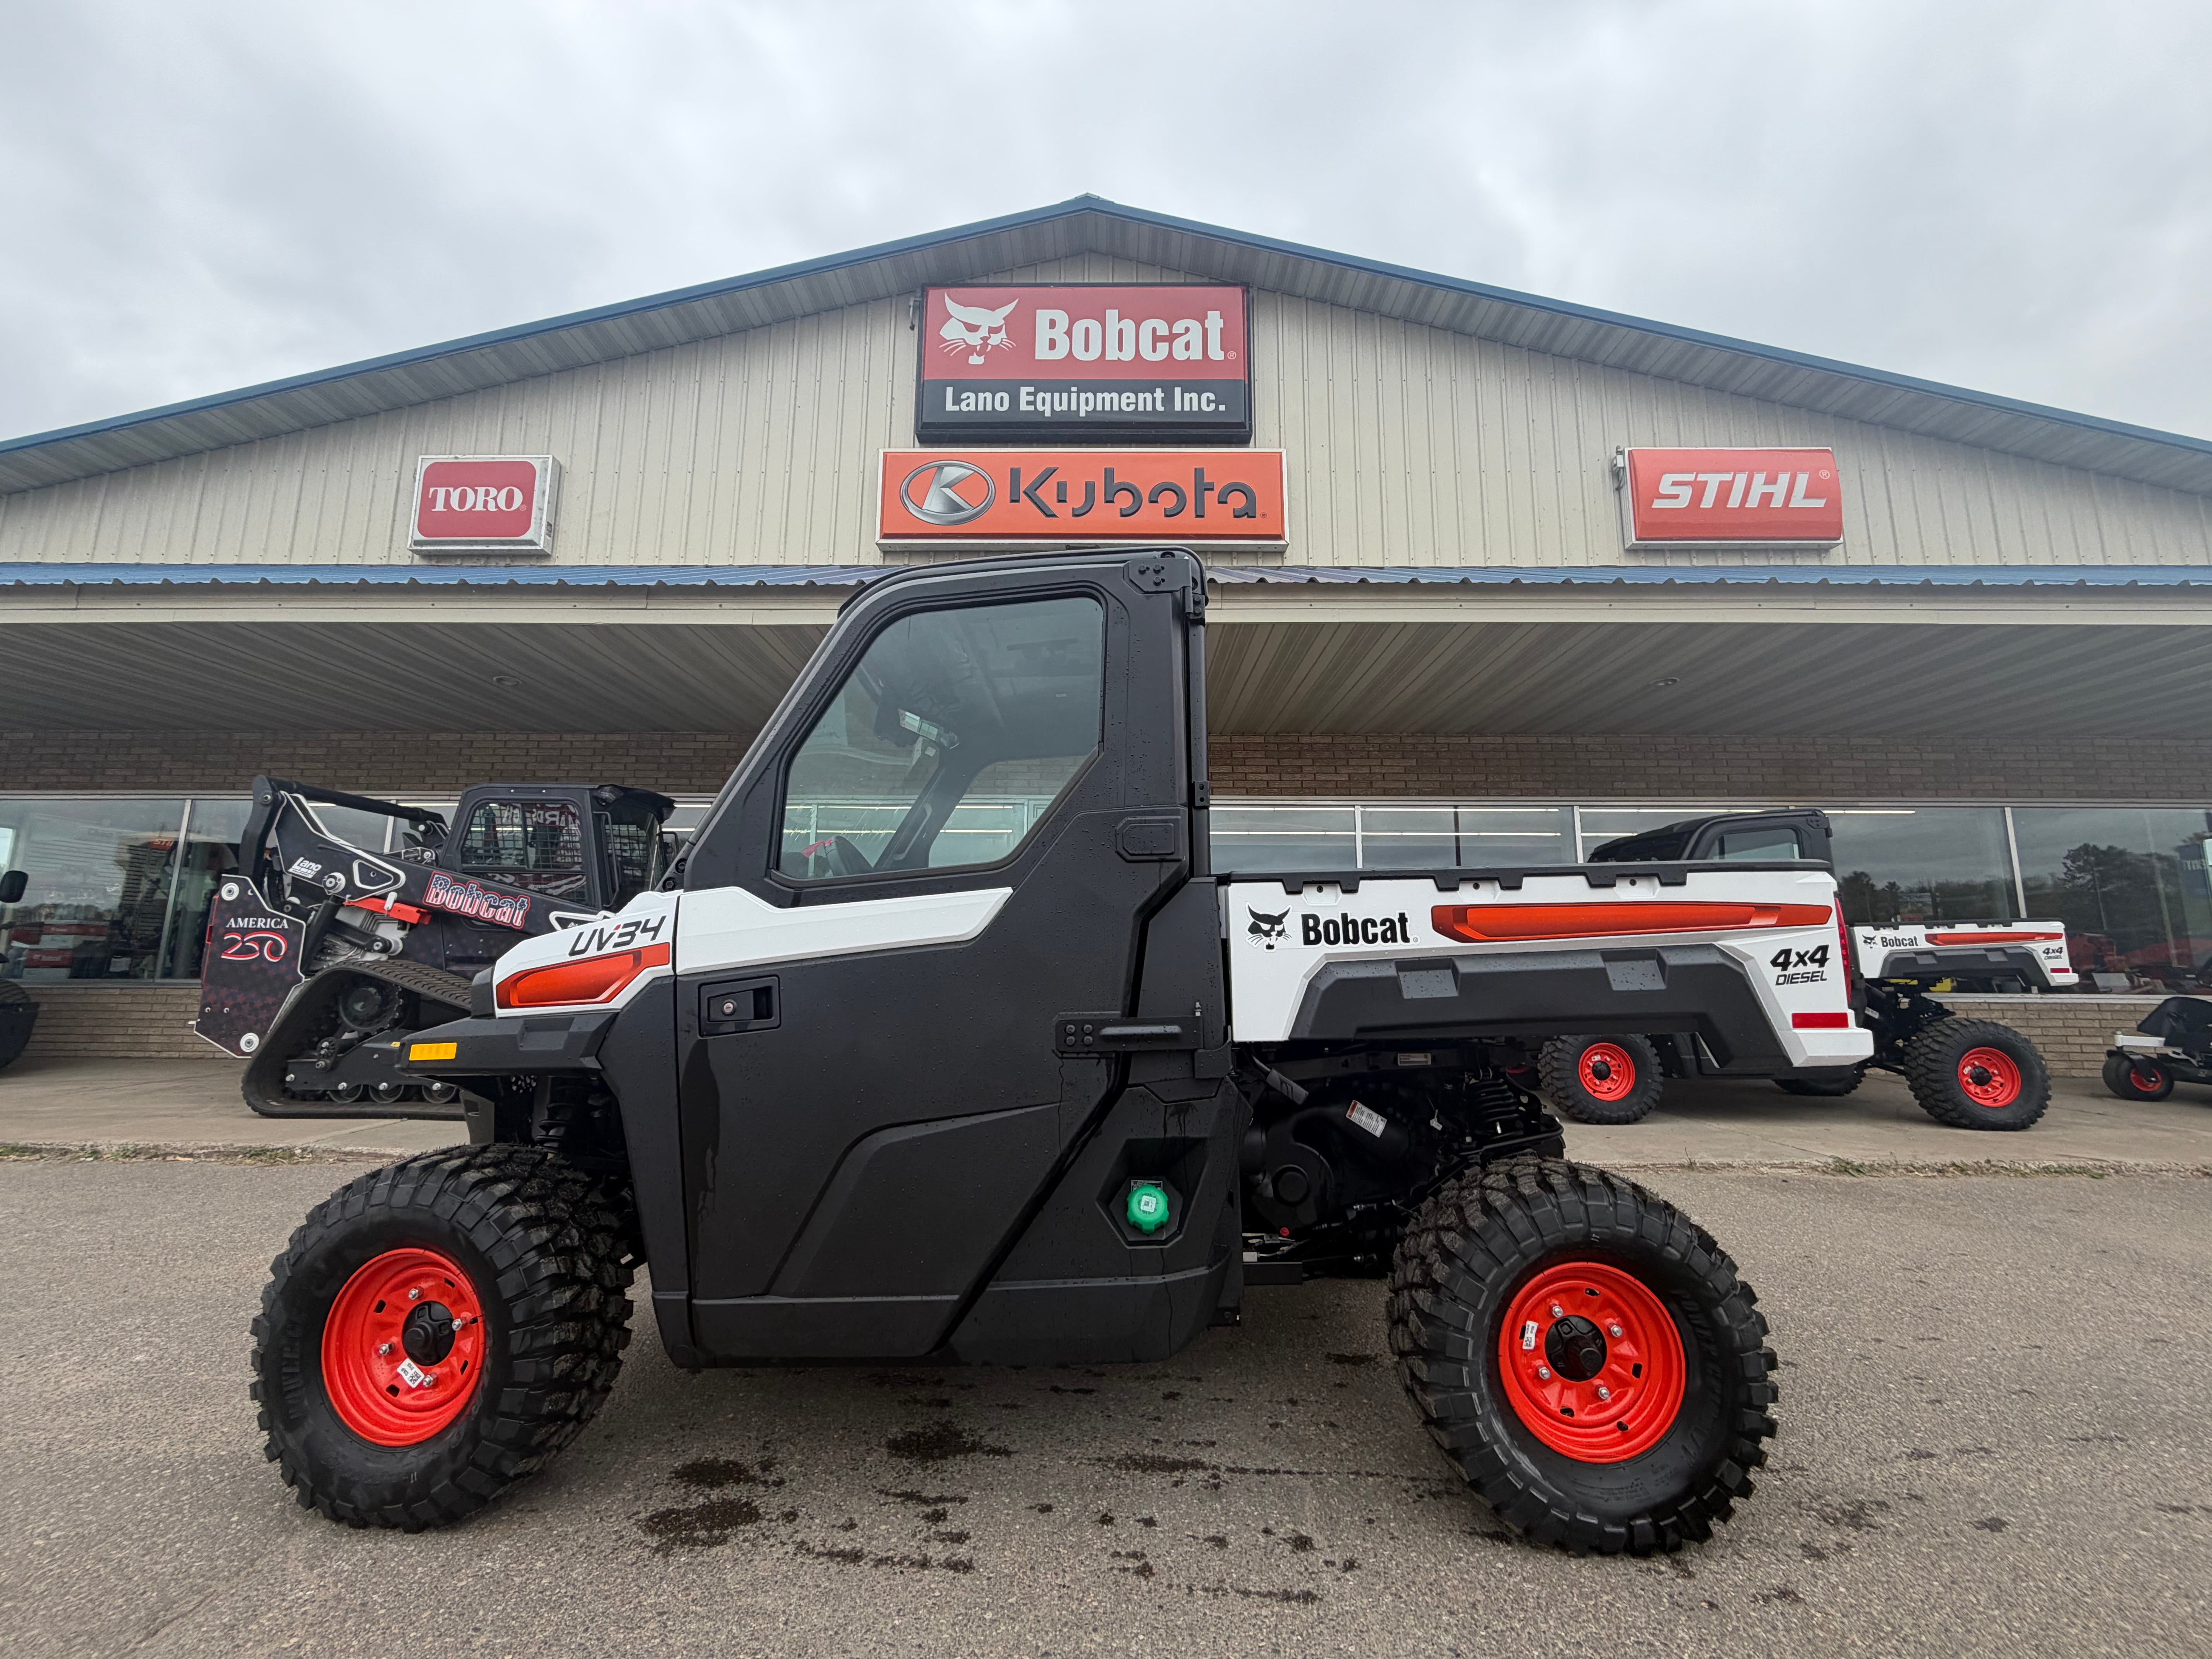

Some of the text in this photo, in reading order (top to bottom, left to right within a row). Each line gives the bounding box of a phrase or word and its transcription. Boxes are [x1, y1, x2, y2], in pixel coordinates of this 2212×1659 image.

[1035, 309, 1224, 362] Bobcat
[945, 386, 1226, 417] Lano Equipment Inc.
[429, 486, 523, 512] TORO
[1009, 467, 1257, 518] Kubota
[1652, 471, 1827, 508] STIHL
[292, 857, 322, 871] Lano
[425, 873, 528, 927] Bobcat
[226, 917, 289, 929] AMERICA
[568, 915, 667, 957] UV34
[1301, 912, 1410, 946] Bobcat
[221, 931, 288, 962] 250
[1880, 936, 1919, 947] Bobcat
[2042, 946, 2063, 955] 4x4
[1769, 944, 1831, 972] 4x4
[1775, 970, 1827, 986] DIESEL
